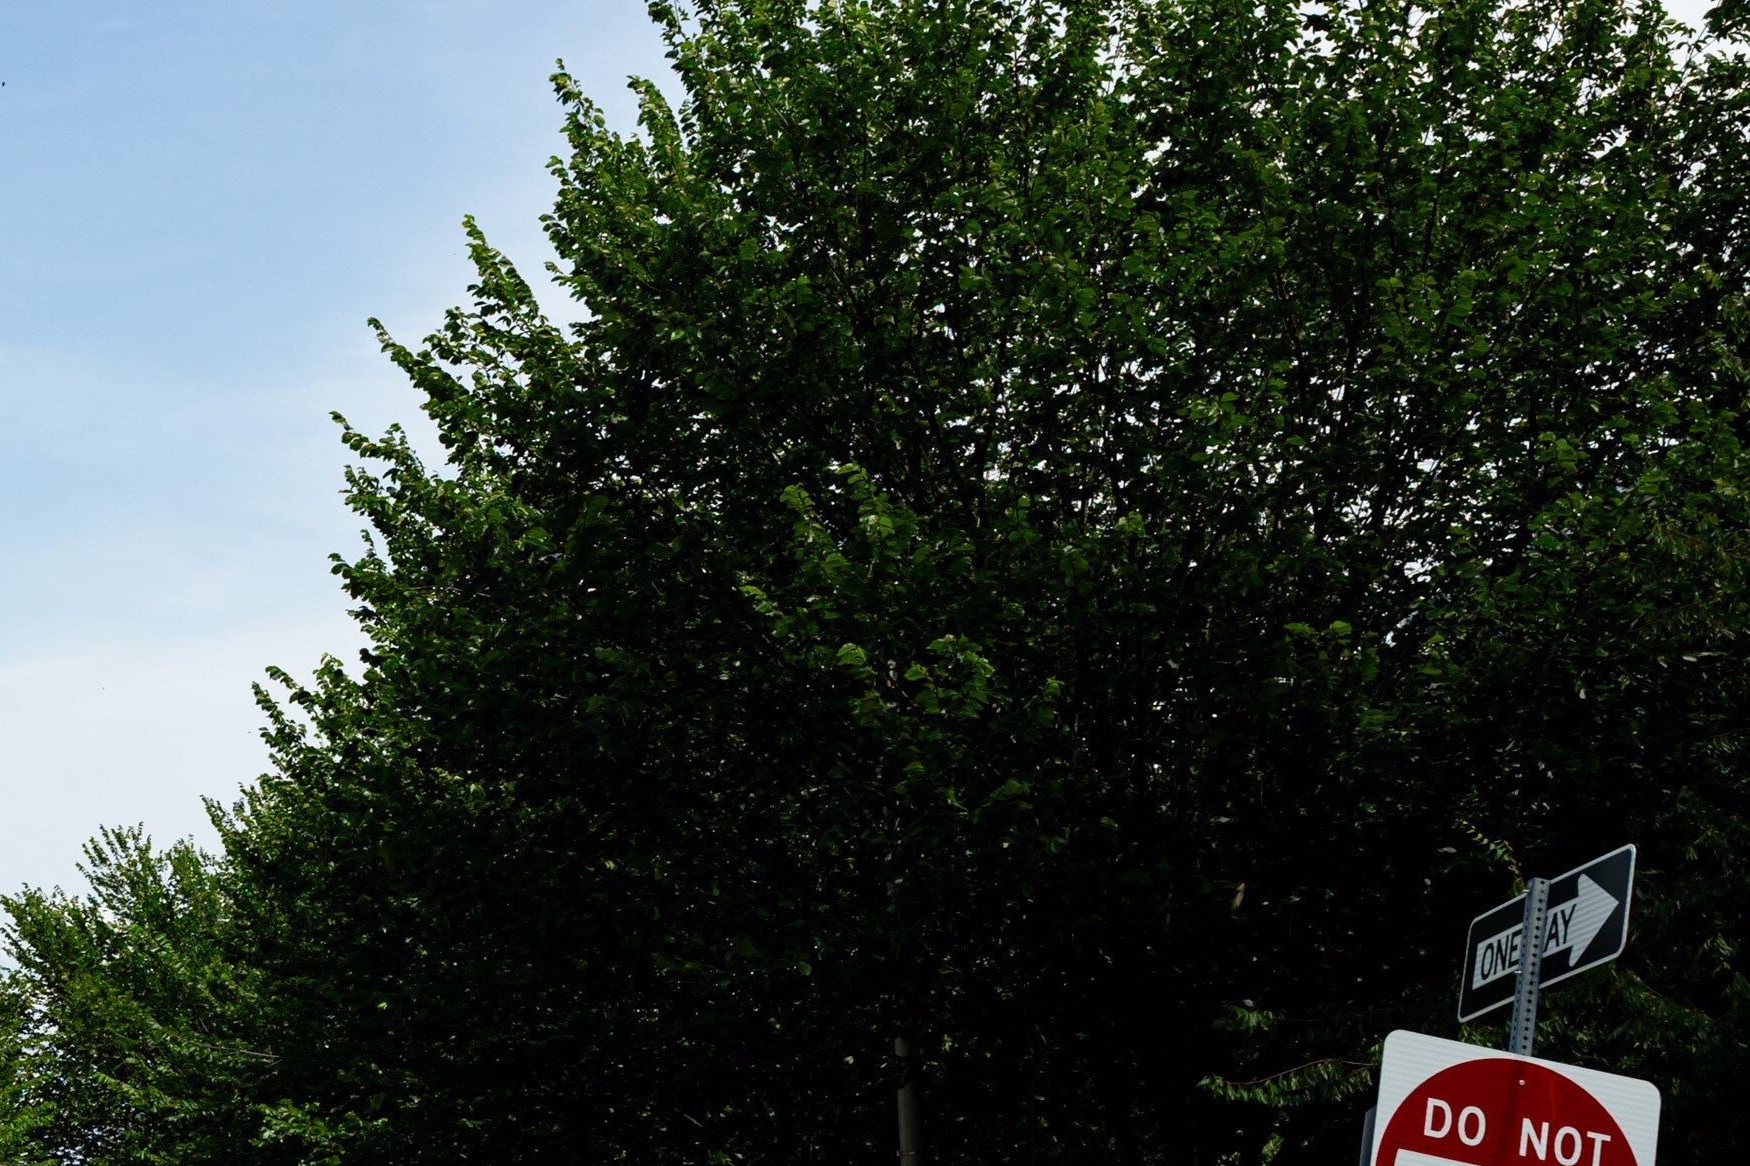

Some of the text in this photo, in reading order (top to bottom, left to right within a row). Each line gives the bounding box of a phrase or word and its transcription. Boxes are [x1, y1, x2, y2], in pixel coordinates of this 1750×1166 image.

[1480, 903, 1578, 981] ONE AY
[1423, 1097, 1487, 1147] DO
